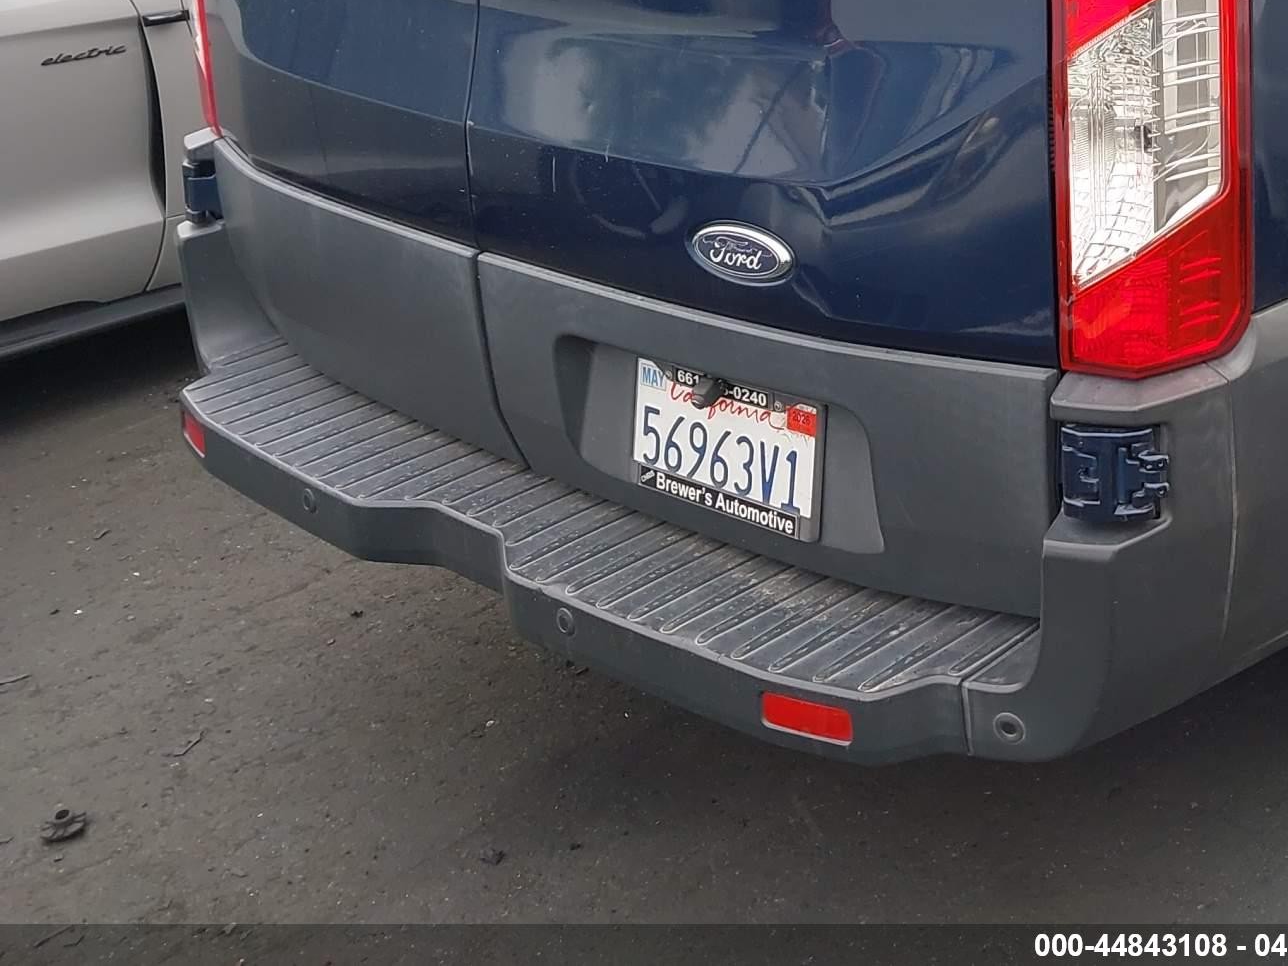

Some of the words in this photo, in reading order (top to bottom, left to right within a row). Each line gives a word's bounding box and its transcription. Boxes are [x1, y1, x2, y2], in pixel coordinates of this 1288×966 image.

[41, 45, 126, 66] electric
[705, 237, 766, 270] Ford
[642, 365, 665, 386] MAY
[677, 369, 699, 385] 661
[724, 384, 767, 407] -0240
[793, 411, 811, 425] 2026
[643, 405, 800, 510] 56963V1
[656, 472, 712, 506] Brewer's
[715, 492, 793, 534] Automotive
